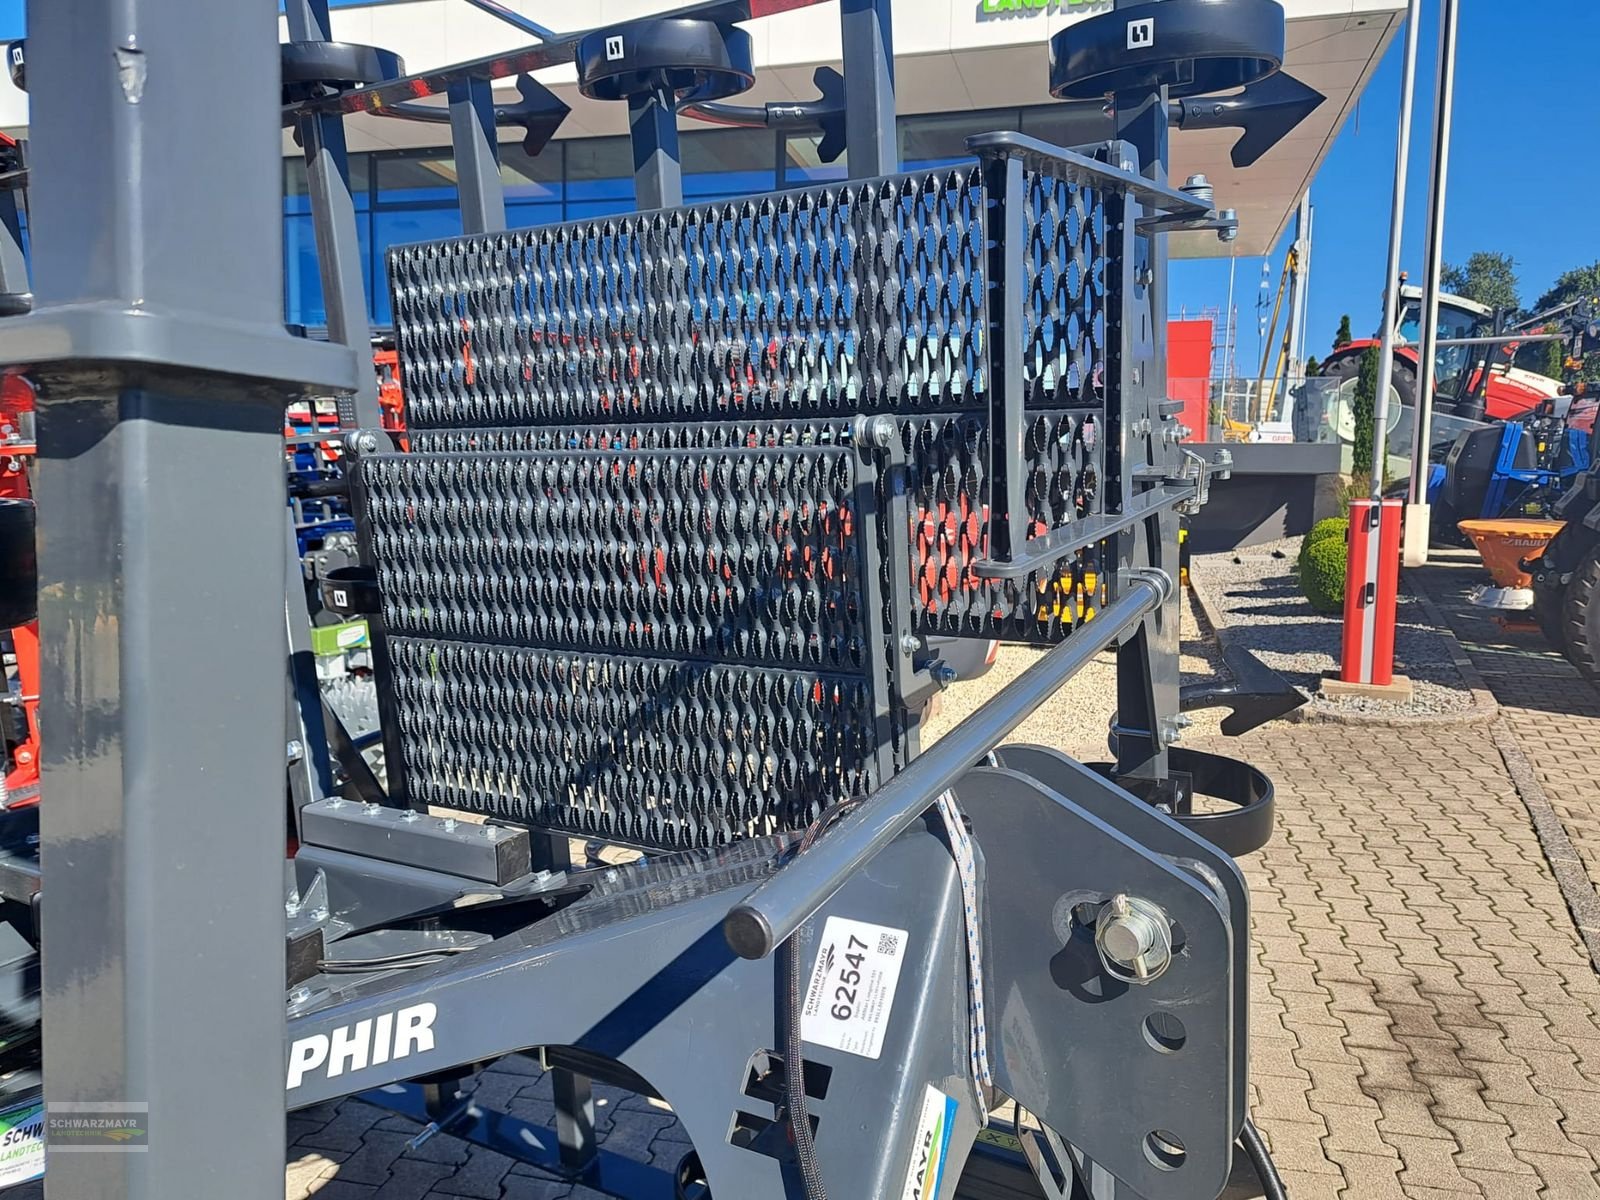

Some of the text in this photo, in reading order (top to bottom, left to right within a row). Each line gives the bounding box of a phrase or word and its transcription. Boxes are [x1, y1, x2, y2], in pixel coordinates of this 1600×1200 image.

[806, 948, 828, 1016] SCHWARZMAYR
[831, 934, 868, 1021] 62547
[0, 1141, 45, 1162] LANDTEC
[3, 1121, 45, 1147] SCHW
